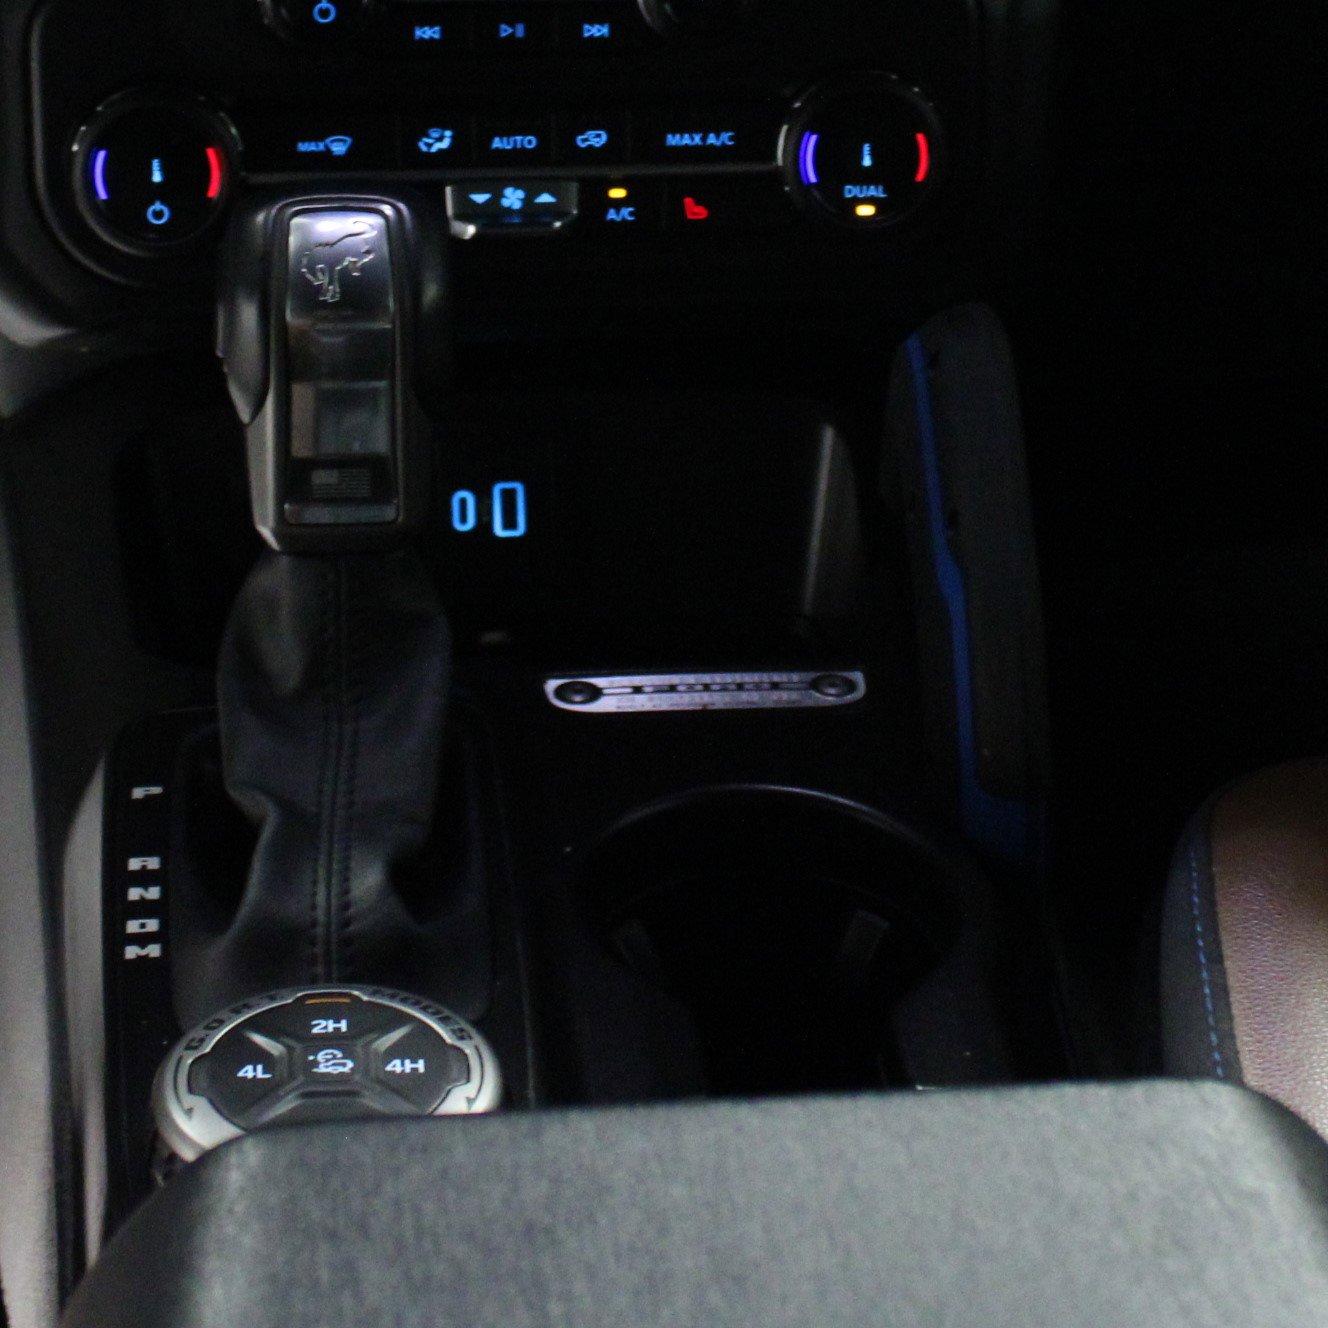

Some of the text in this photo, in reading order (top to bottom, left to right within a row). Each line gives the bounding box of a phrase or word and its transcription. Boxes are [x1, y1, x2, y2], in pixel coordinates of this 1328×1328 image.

[297, 141, 325, 152] MAX
[491, 135, 538, 150] AUTO
[666, 131, 735, 147] MAX A/C
[843, 184, 888, 199] DUAL
[606, 207, 636, 222] A/C
[130, 785, 164, 800] P
[127, 855, 161, 872] R
[127, 886, 161, 901] N
[124, 943, 161, 960] M
[310, 1019, 348, 1034] 2H
[236, 1064, 272, 1080] 4L
[384, 1058, 426, 1075] 4H
